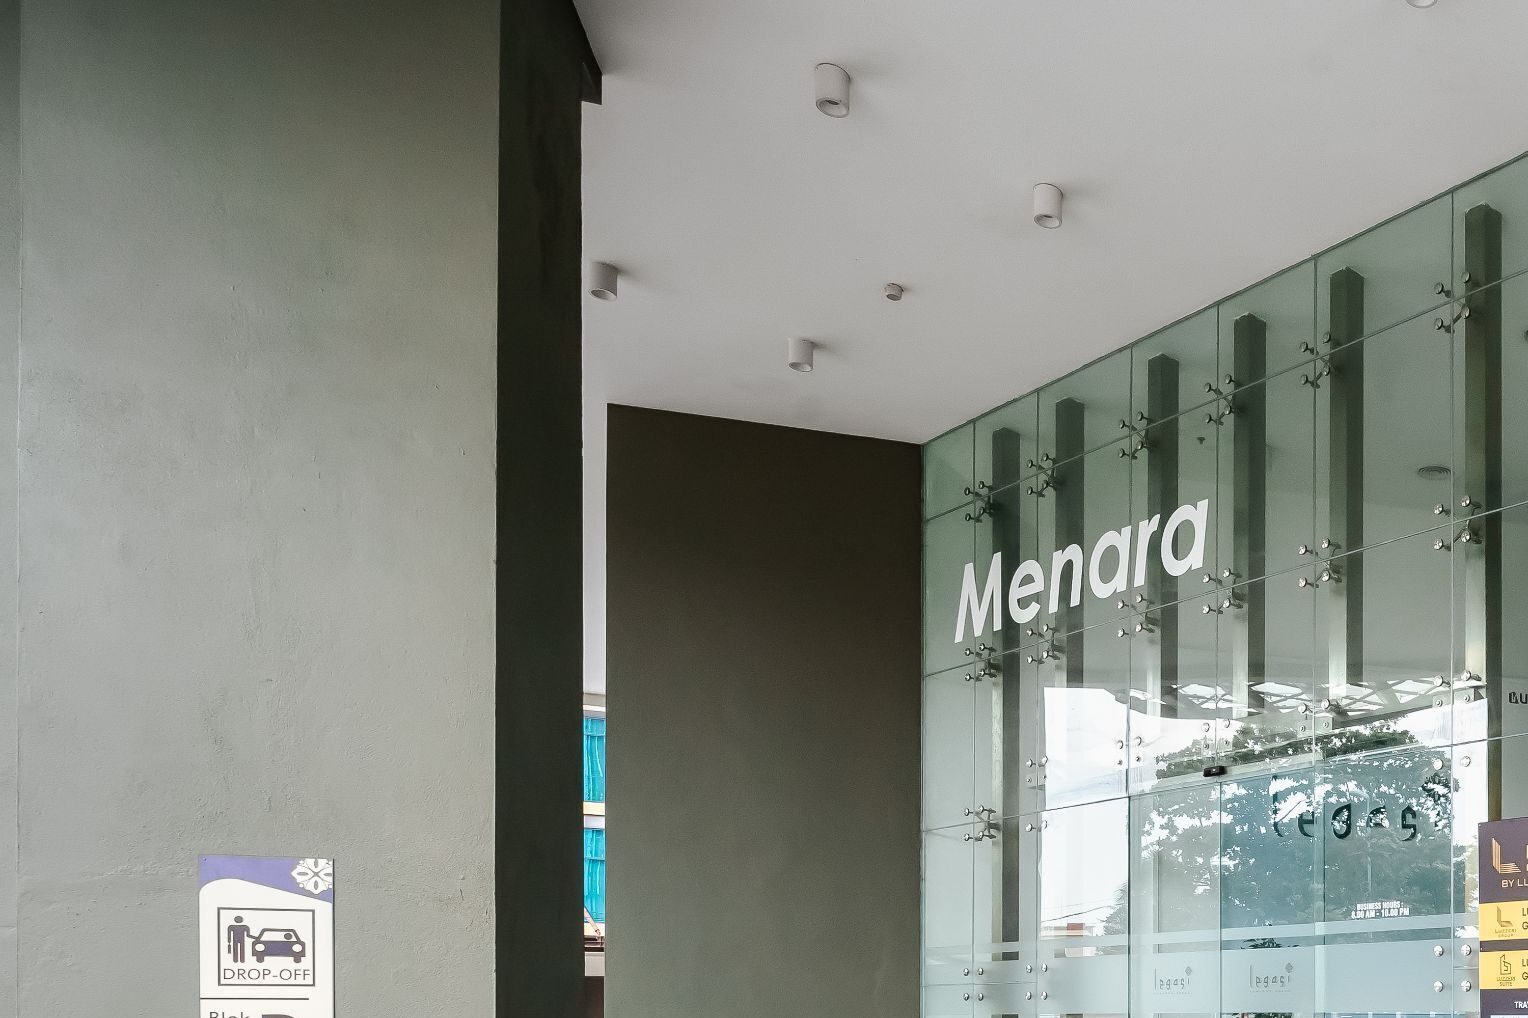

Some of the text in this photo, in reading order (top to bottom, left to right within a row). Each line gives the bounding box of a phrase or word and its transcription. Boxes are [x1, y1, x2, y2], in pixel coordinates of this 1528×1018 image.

[954, 498, 1209, 644] Menara
[1501, 879, 1515, 888] BY
[1365, 909, 1376, 919] AM
[1399, 907, 1410, 917] PM
[223, 968, 311, 981] DROP-OFF
